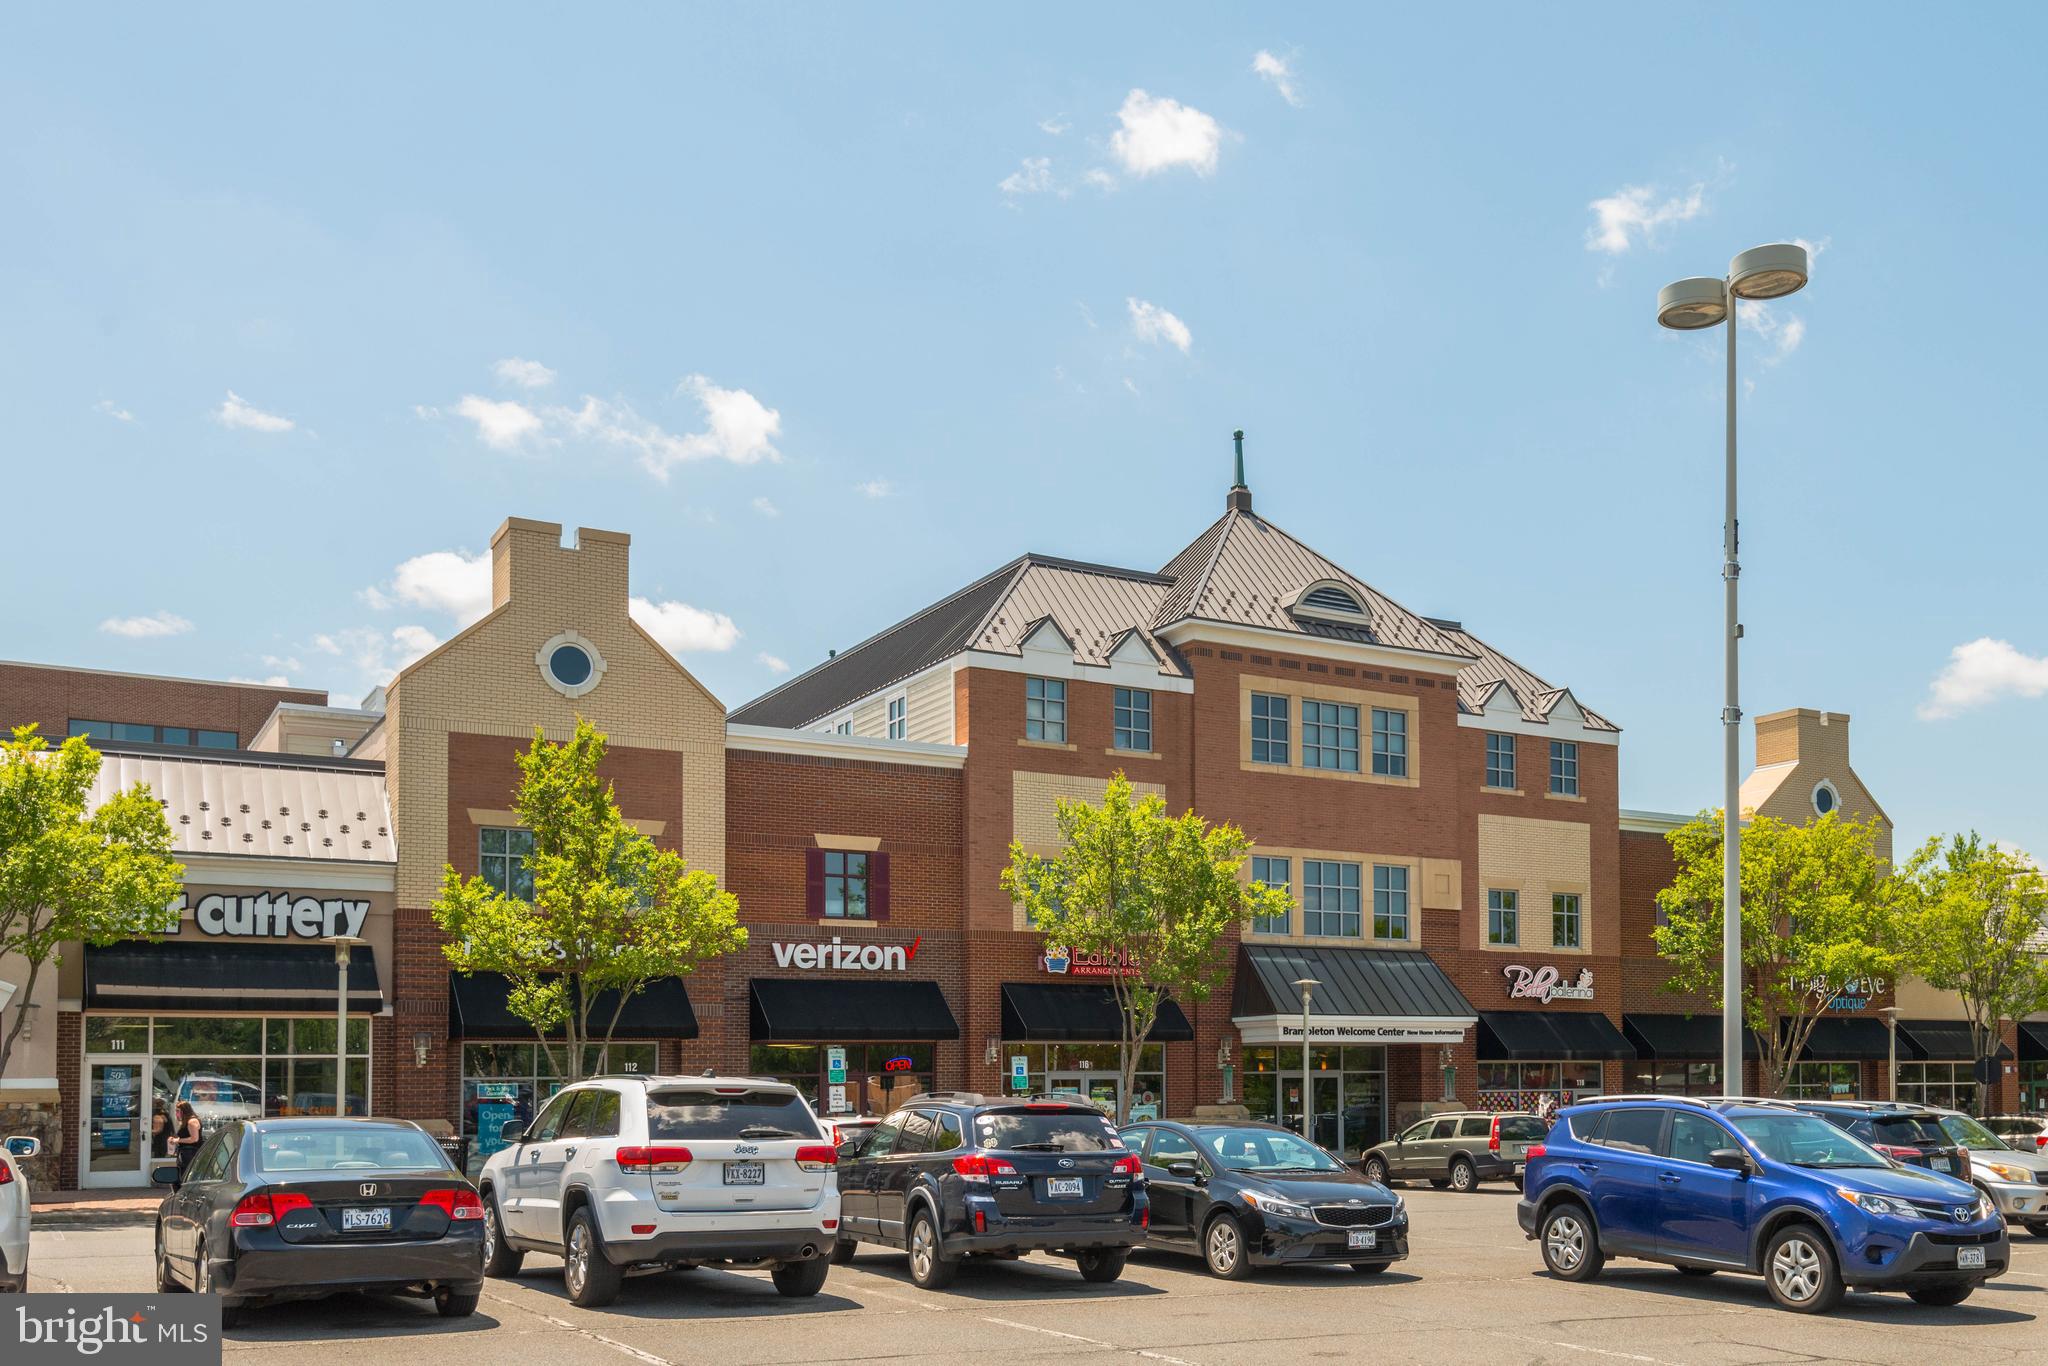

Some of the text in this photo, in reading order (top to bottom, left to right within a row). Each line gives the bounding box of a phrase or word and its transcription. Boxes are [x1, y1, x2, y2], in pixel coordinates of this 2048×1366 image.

[196, 891, 370, 938] cuttery
[771, 936, 906, 971] verizon
[1503, 964, 1560, 1005] Bella
[1860, 976, 1885, 1001] Eye
[1827, 995, 1867, 1014] Optique
[1336, 1027, 1376, 1037] Welcome
[1377, 1027, 1405, 1037] Center
[111, 1039, 126, 1051] 111
[624, 1062, 638, 1072] 112
[885, 1059, 912, 1071] OPEN
[482, 1110, 511, 1121] Open
[734, 1144, 759, 1155] Jeep
[726, 1168, 762, 1180] VKX-8227
[1049, 1179, 1082, 1193] VAC-2094
[344, 1213, 389, 1226] WLS-7626
